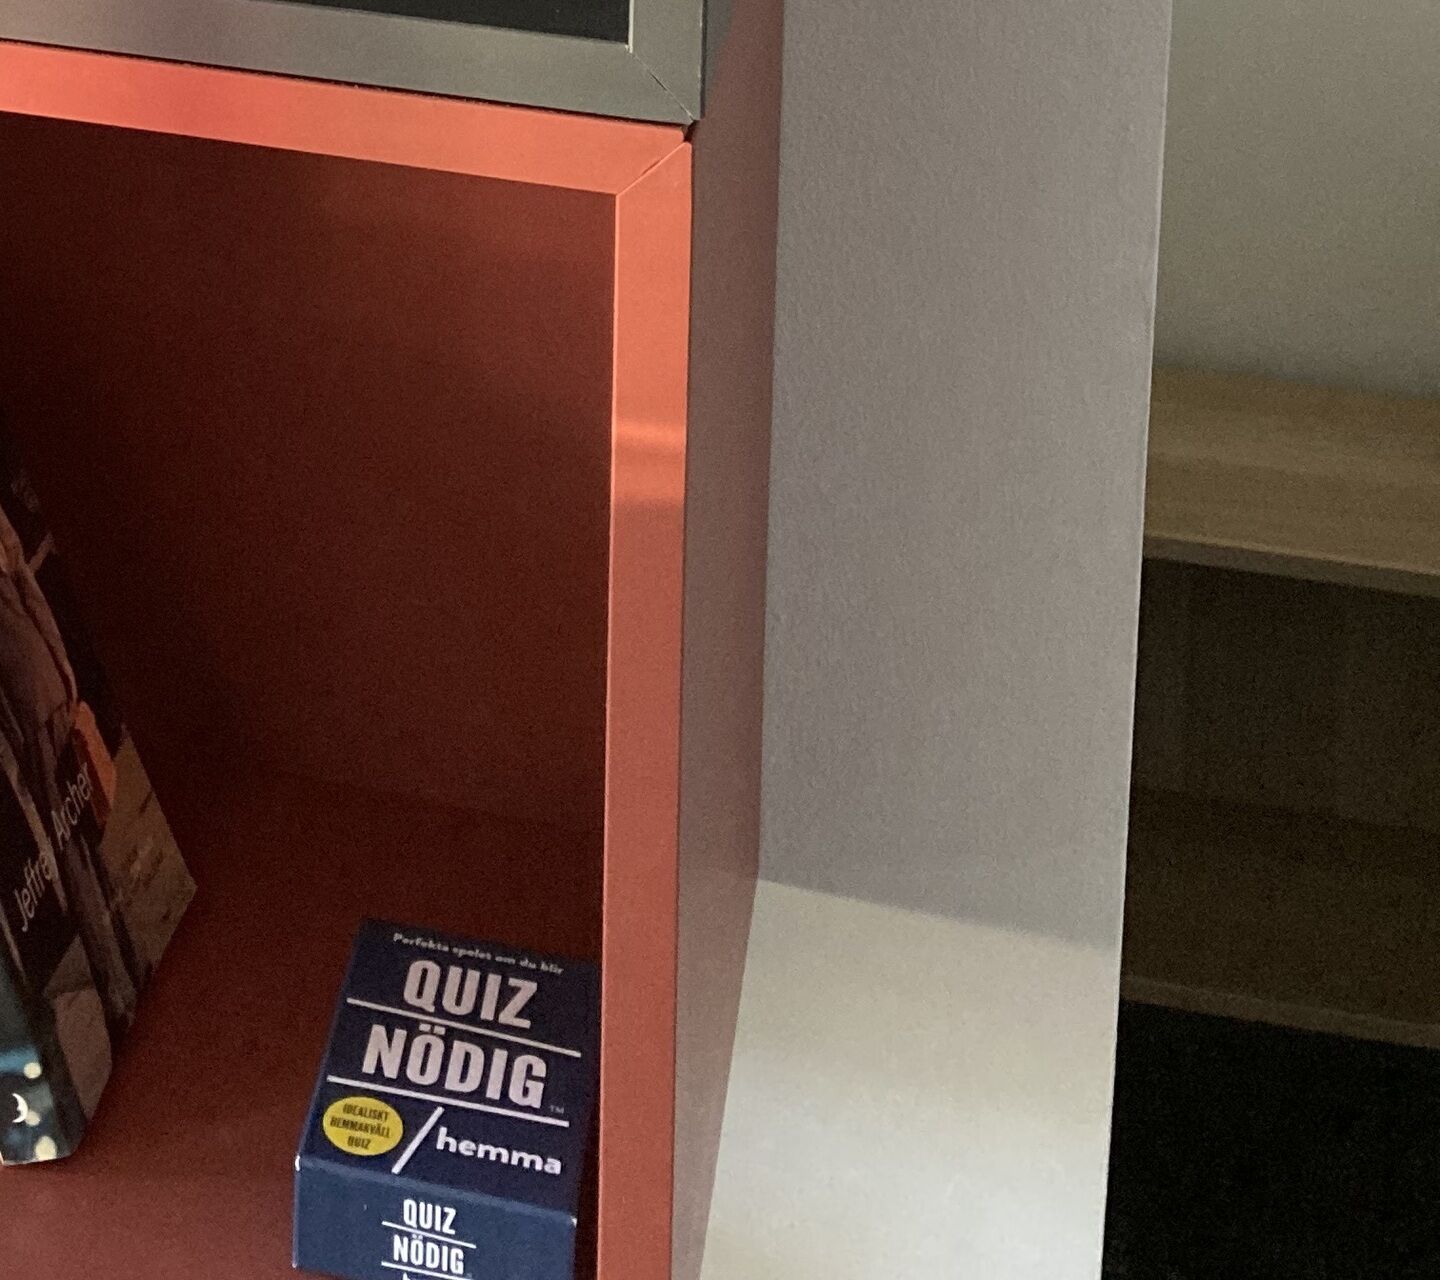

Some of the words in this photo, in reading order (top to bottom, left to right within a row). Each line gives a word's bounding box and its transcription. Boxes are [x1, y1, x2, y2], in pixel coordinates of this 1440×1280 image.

[51, 761, 93, 851] Archer
[495, 954, 516, 965] om
[519, 957, 537, 970] du
[403, 960, 538, 1029] QUIZ
[362, 1023, 548, 1109] NÖDIG
[403, 1198, 457, 1235] QUIZ
[393, 1233, 465, 1275] NÖDIG
